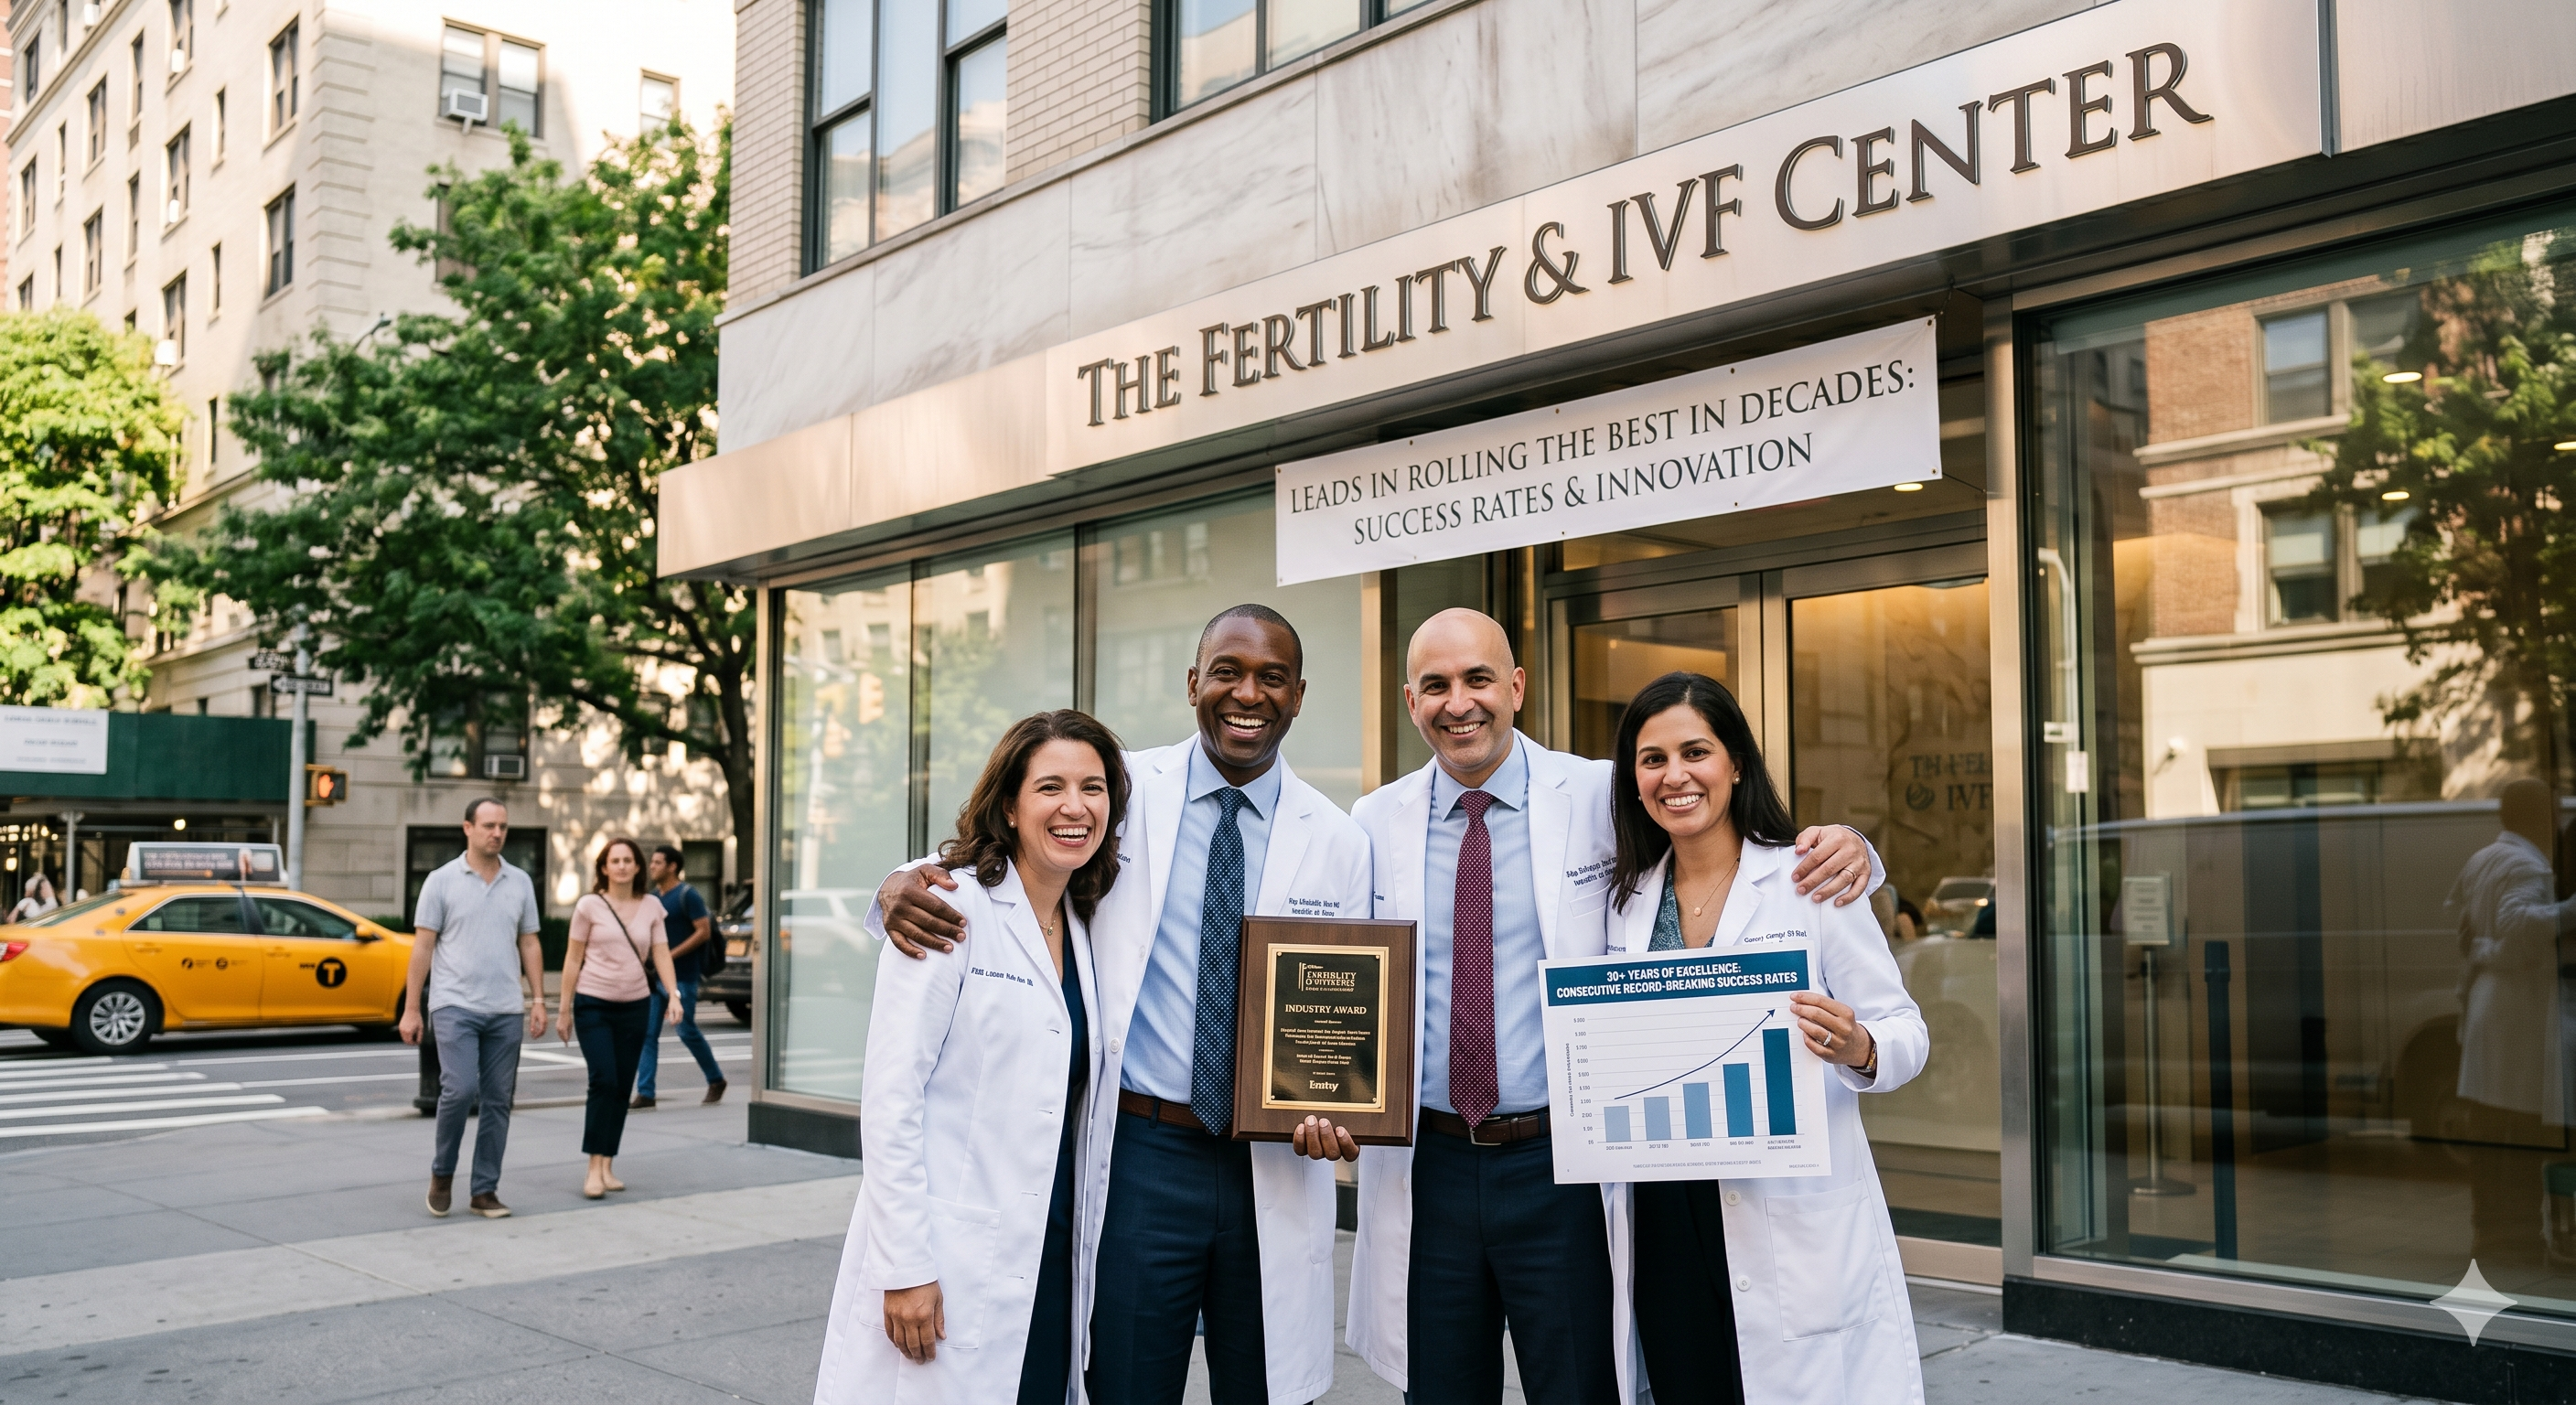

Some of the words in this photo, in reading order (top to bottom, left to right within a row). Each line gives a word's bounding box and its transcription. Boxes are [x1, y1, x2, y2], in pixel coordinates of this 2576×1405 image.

[1078, 345, 1181, 427] THE
[1199, 246, 1507, 396] FERTILITY
[1524, 221, 1588, 305] &
[1607, 164, 1743, 284] IVF
[1775, 42, 2214, 231] CENTER
[1290, 476, 1363, 514] LEADS
[1370, 470, 1400, 498] IN
[1408, 443, 1529, 492] ROLLING
[1536, 428, 1595, 465] THE
[1607, 409, 1675, 452] BEST
[1690, 399, 1726, 432] IN
[1739, 359, 1916, 426] DECADES:
[1354, 504, 1462, 545] SUCCESS
[1472, 484, 1553, 525] RATES
[1565, 477, 1588, 508] &
[1596, 433, 1812, 503] INNOVATION
[1284, 1004, 1332, 1014] INDUSTRY
[1333, 1004, 1368, 1015] AWARD
[1556, 984, 1622, 999] CONSECUTIVE
[1623, 978, 1716, 994] RECORD-BREAKING
[1716, 974, 1764, 988] SUCCESS
[1765, 971, 1798, 984] RATES
[1606, 970, 1626, 982] 30+
[1627, 968, 1659, 981] YEARS
[1661, 967, 1675, 979] OF
